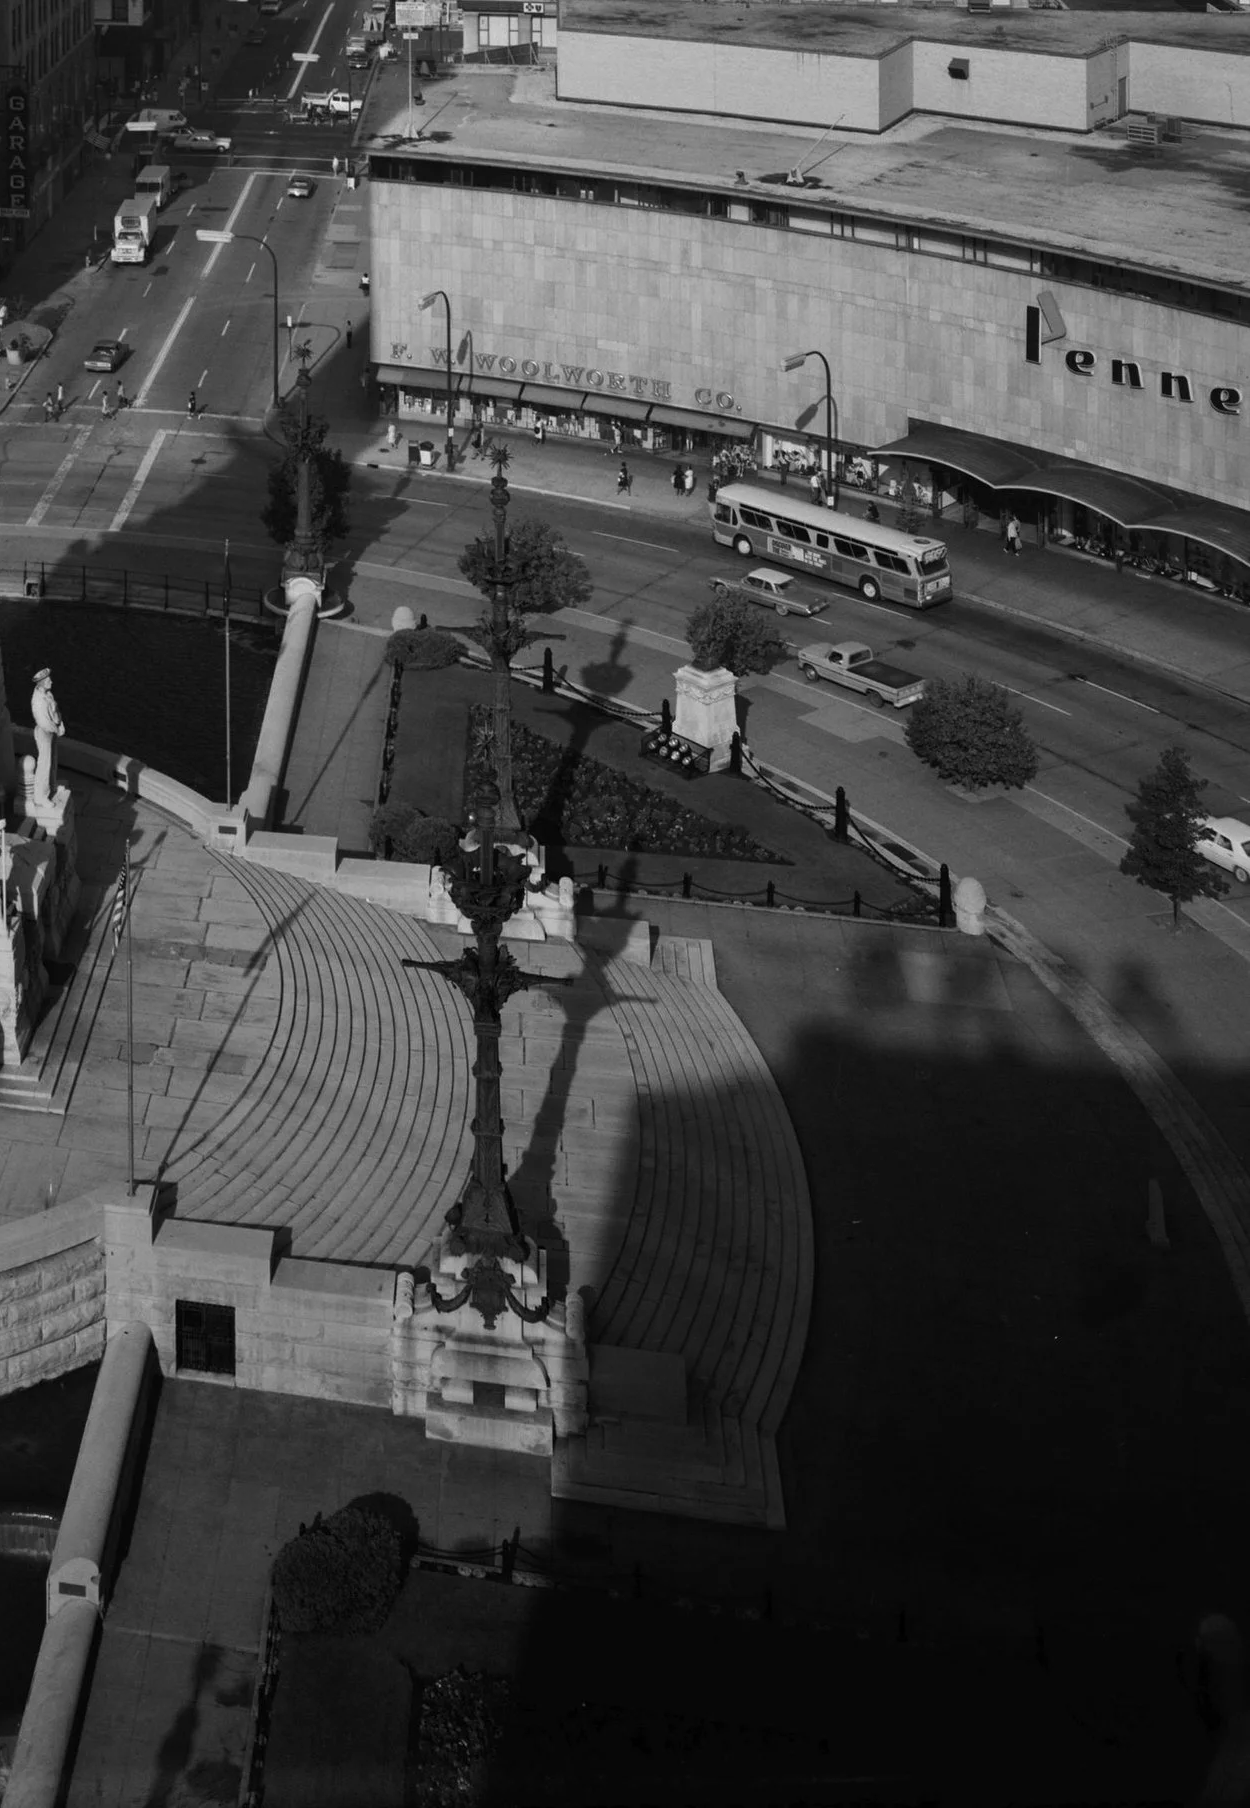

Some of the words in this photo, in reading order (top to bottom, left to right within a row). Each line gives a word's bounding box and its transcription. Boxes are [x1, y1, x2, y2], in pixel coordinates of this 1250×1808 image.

[8, 95, 26, 209] GARAGE
[390, 342, 413, 360] F.
[430, 346, 456, 365] W.
[474, 352, 673, 401] WOOLWORTH
[694, 387, 743, 412] CO.
